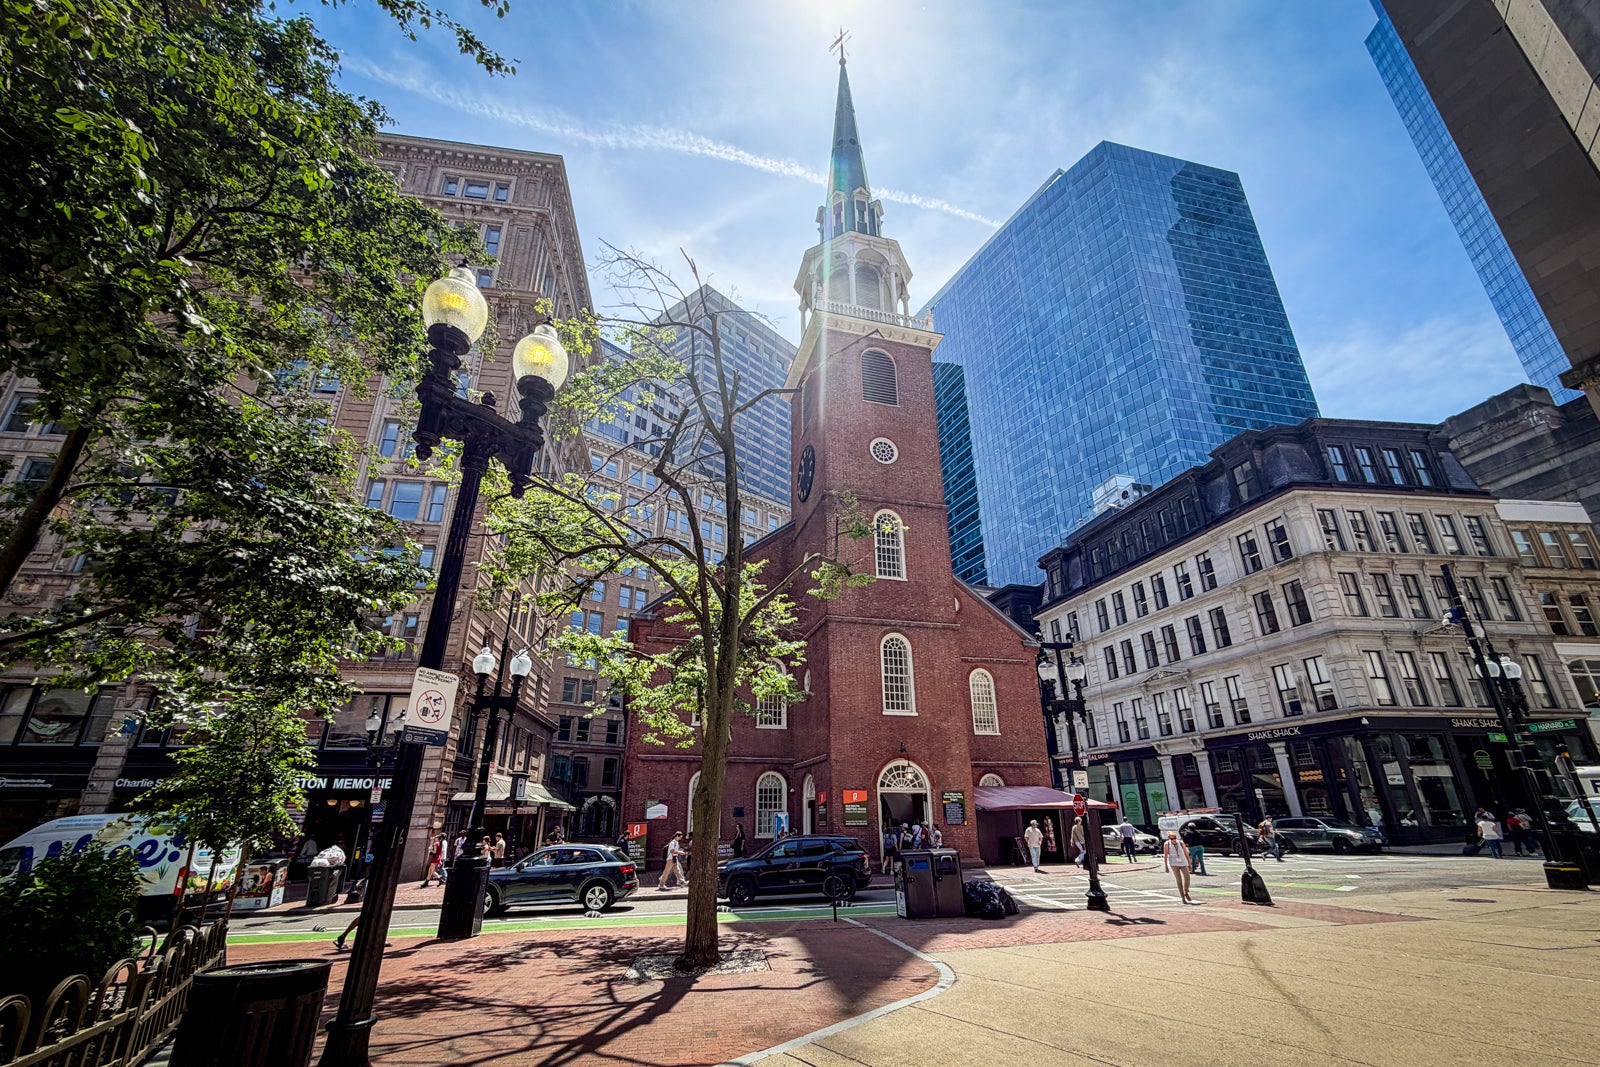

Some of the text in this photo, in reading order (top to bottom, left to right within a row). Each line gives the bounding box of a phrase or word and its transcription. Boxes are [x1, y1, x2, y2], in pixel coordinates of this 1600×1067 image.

[427, 671, 457, 682] AMPLIFICATION
[1451, 718, 1503, 728] SHAKE SHAC
[1538, 720, 1564, 730] HARVARD
[1248, 726, 1301, 741] SHAKE SHACK
[115, 778, 154, 788] Charlie
[292, 777, 393, 789] STON MEMORIE
[1073, 800, 1085, 810] STOP
[633, 824, 640, 837] R
